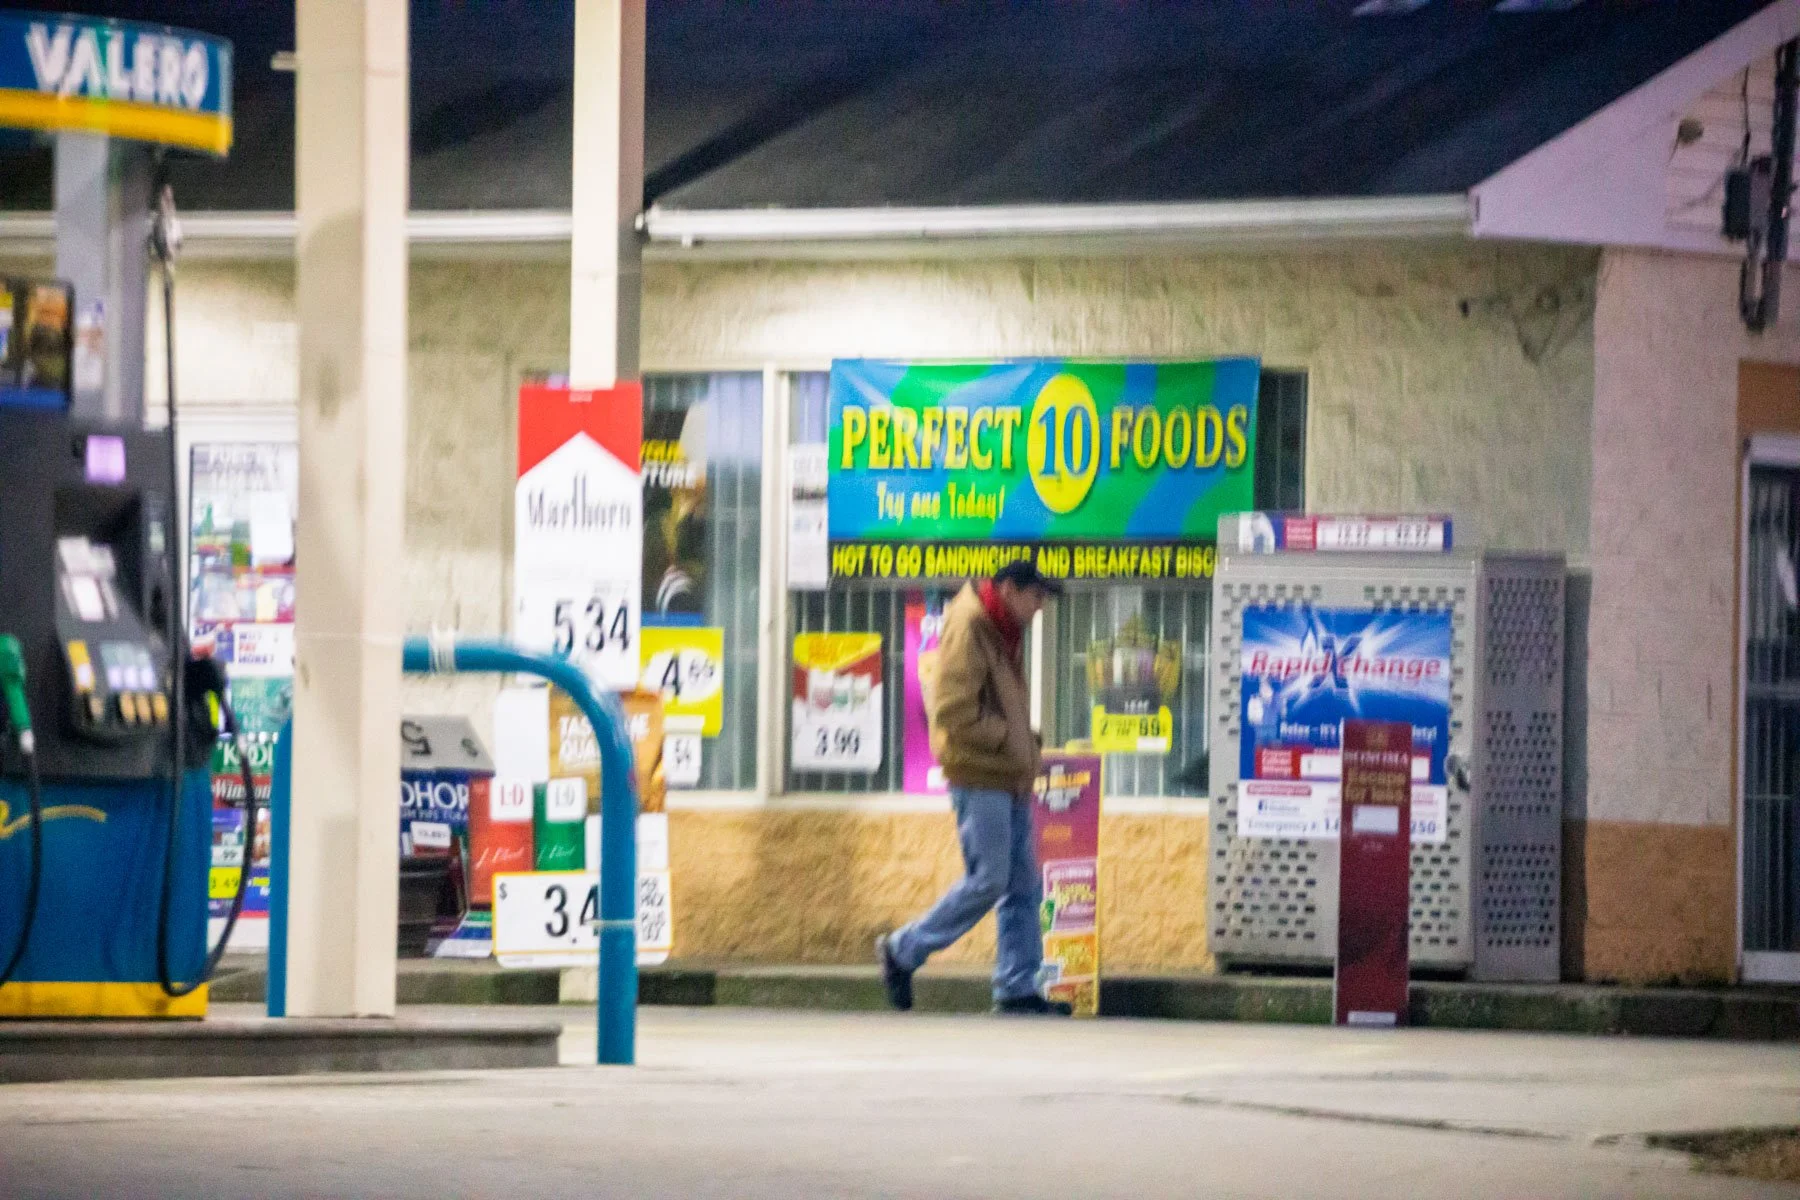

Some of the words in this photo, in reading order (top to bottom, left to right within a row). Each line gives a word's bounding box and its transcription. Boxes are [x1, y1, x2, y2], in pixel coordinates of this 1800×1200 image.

[26, 22, 209, 107] VALERO
[841, 404, 1021, 470] PERFECT
[1038, 405, 1093, 480] 10
[1110, 404, 1248, 468] FOODS
[877, 481, 904, 525] Try
[947, 481, 1005, 523] Today!
[833, 544, 867, 577] HOT
[870, 544, 893, 577] TO
[896, 544, 921, 577] GO
[1036, 545, 1071, 578] AND
[1073, 545, 1172, 578] BREAKFAST
[1175, 545, 1219, 578] BISC
[1250, 651, 1332, 683] Rapid
